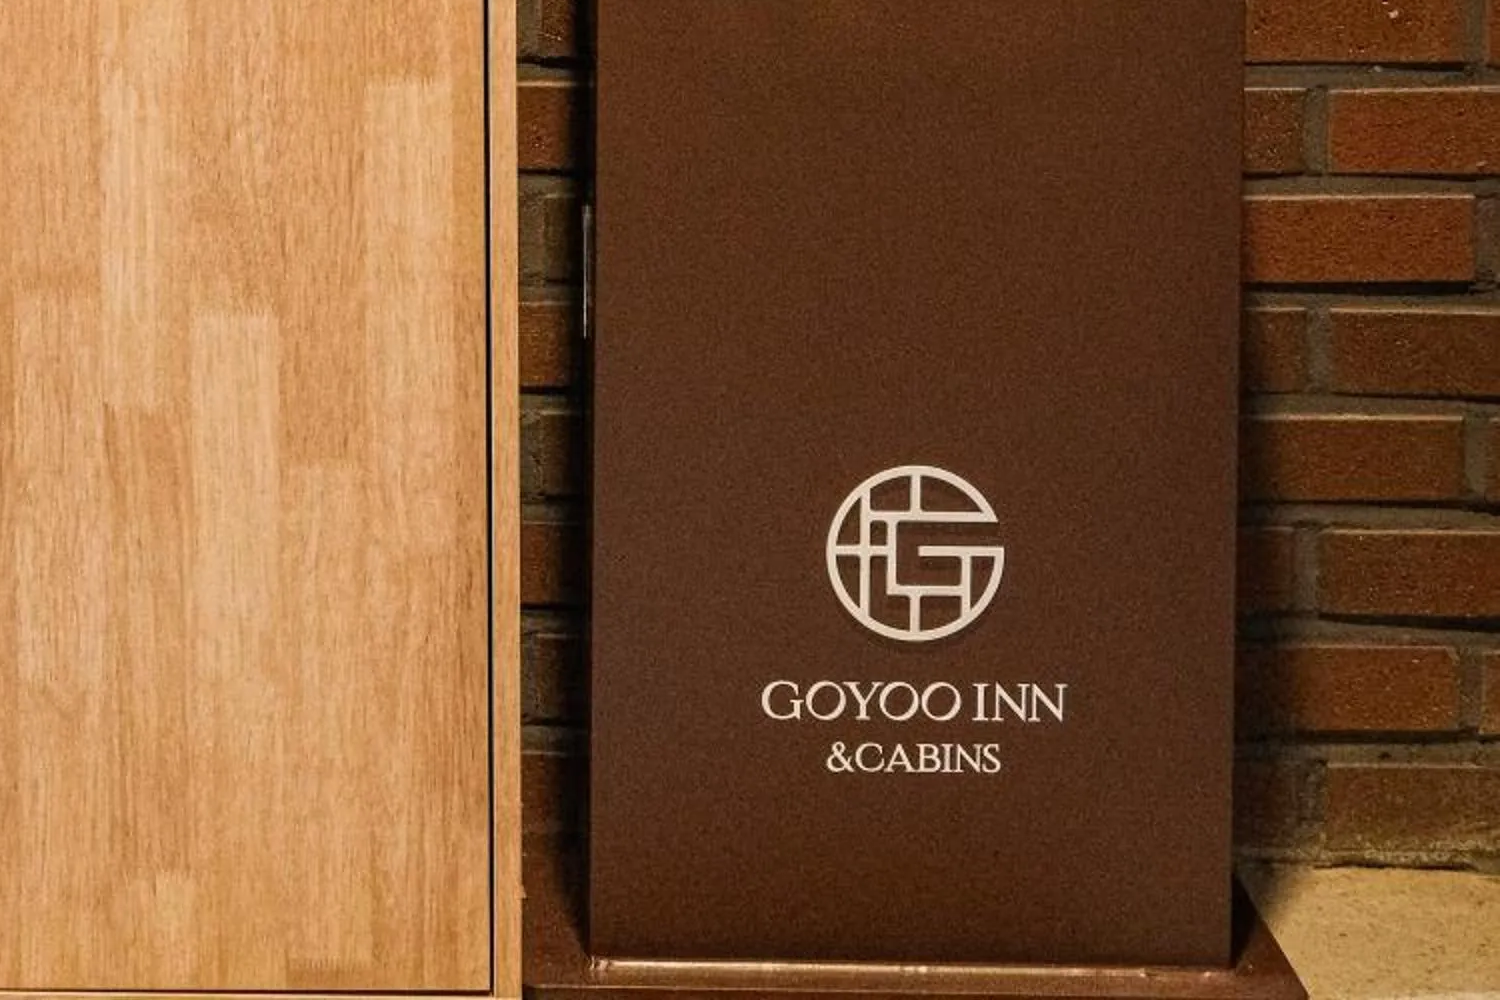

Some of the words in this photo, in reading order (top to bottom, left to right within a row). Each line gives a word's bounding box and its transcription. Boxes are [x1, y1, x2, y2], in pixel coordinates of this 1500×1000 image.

[761, 679, 962, 722] GOYOO
[971, 682, 1068, 723] INN
[826, 741, 1002, 774] &CABINS
